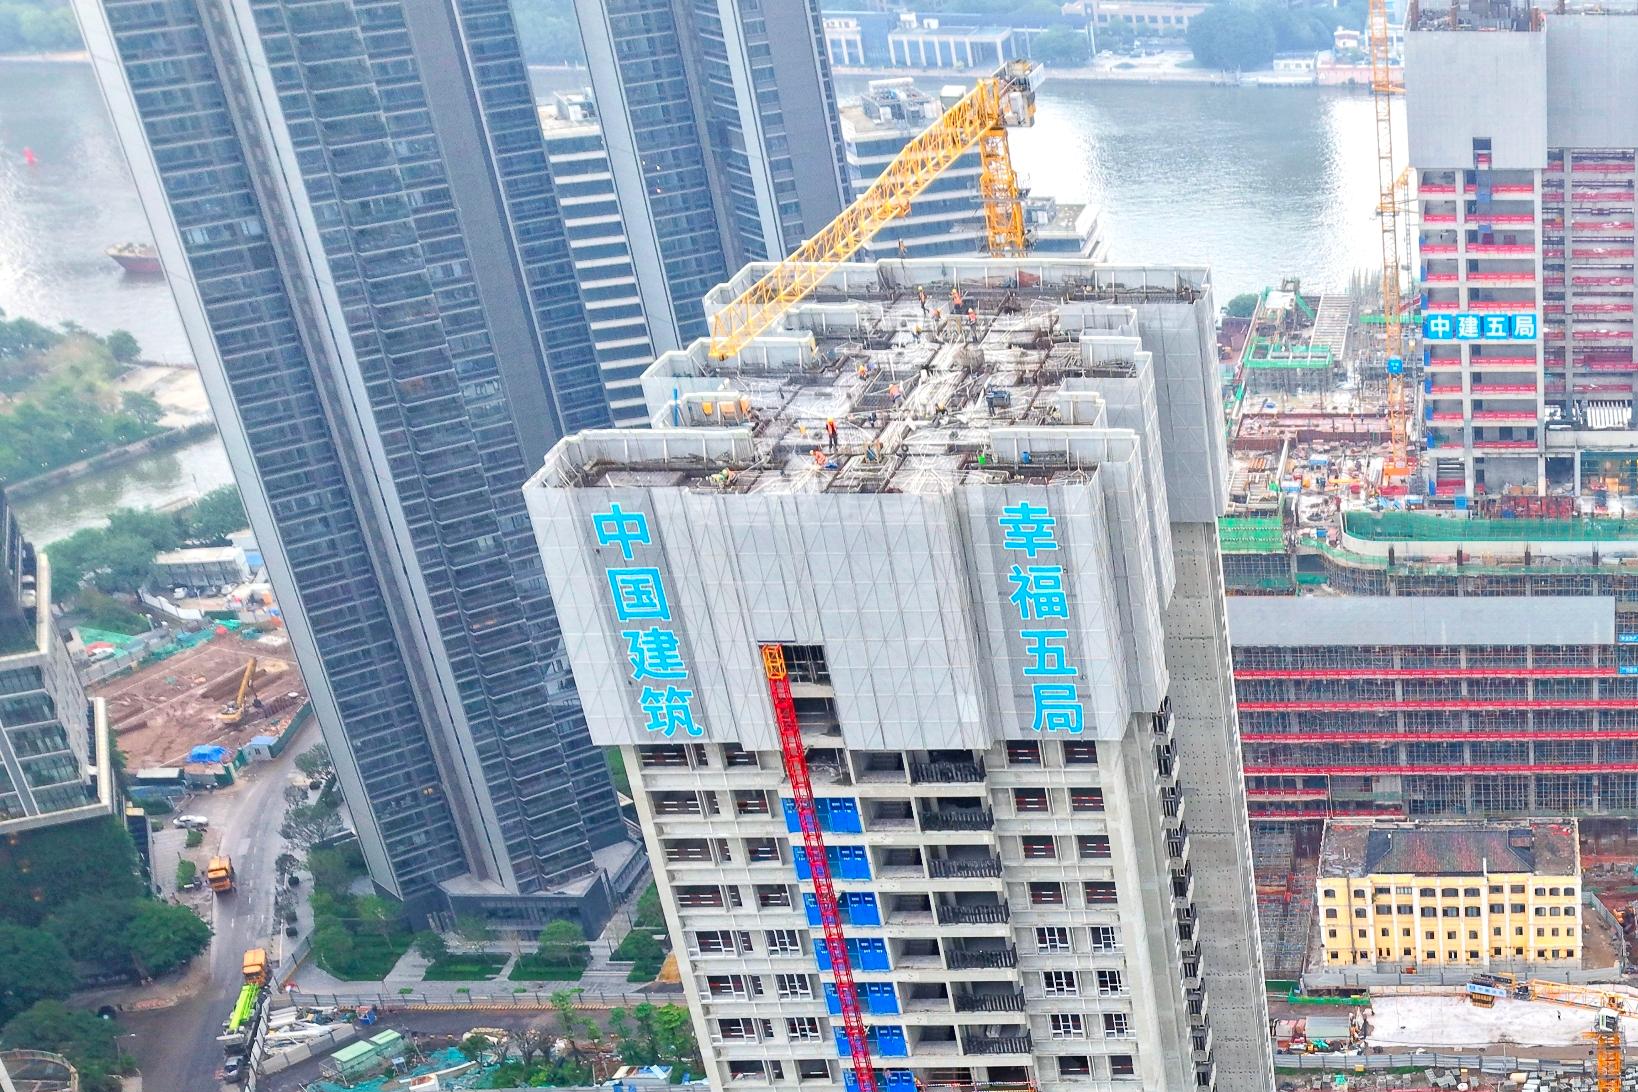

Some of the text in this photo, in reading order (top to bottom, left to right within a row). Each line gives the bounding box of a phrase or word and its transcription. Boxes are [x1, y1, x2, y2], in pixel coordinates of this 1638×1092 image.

[1430, 316, 1535, 338] 中建五局
[592, 502, 704, 737] 中国建筑
[998, 502, 1085, 734] 幸福五局
